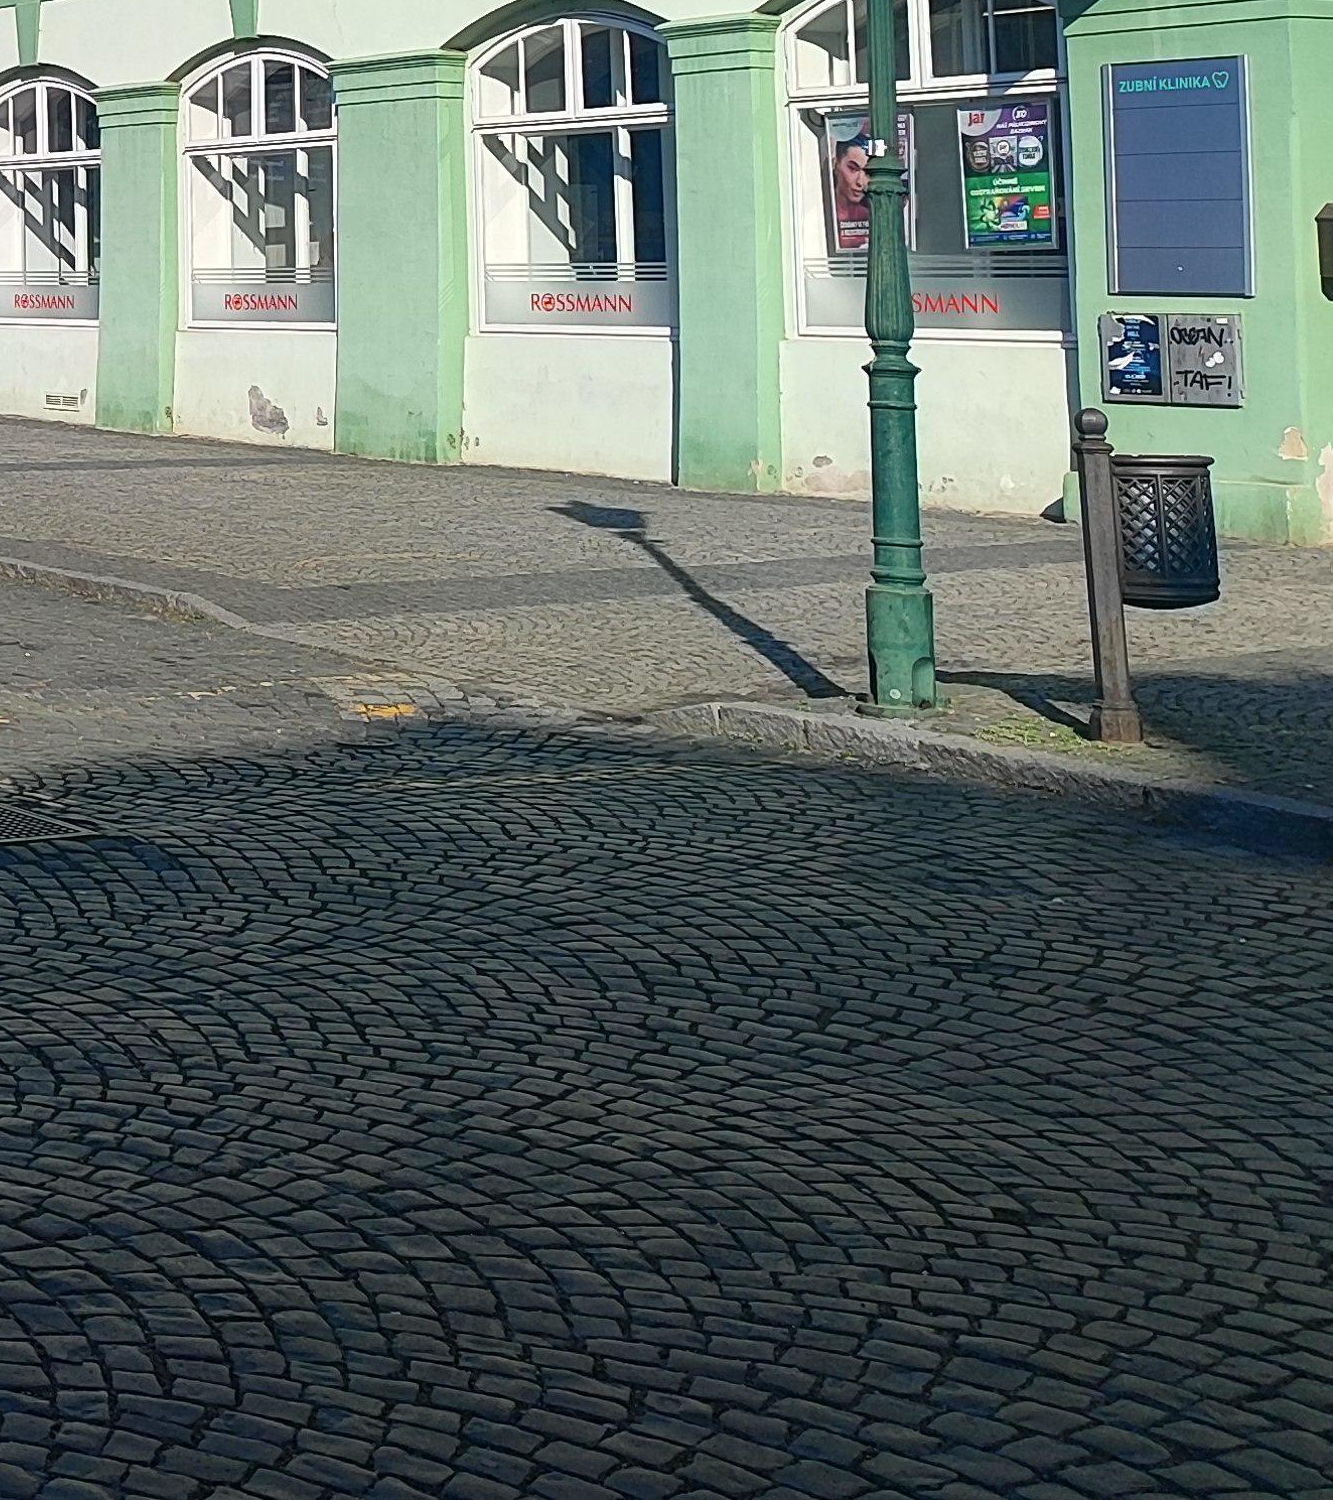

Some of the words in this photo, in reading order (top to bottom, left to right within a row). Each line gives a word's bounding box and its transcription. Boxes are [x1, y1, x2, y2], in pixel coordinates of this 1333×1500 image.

[1119, 76, 1157, 93] ZUBNÍ
[1159, 76, 1210, 90] KLINIKA
[14, 293, 75, 309] ROSSMANN
[224, 293, 298, 311] ROSSMANN
[530, 293, 632, 312] ROSSMANN
